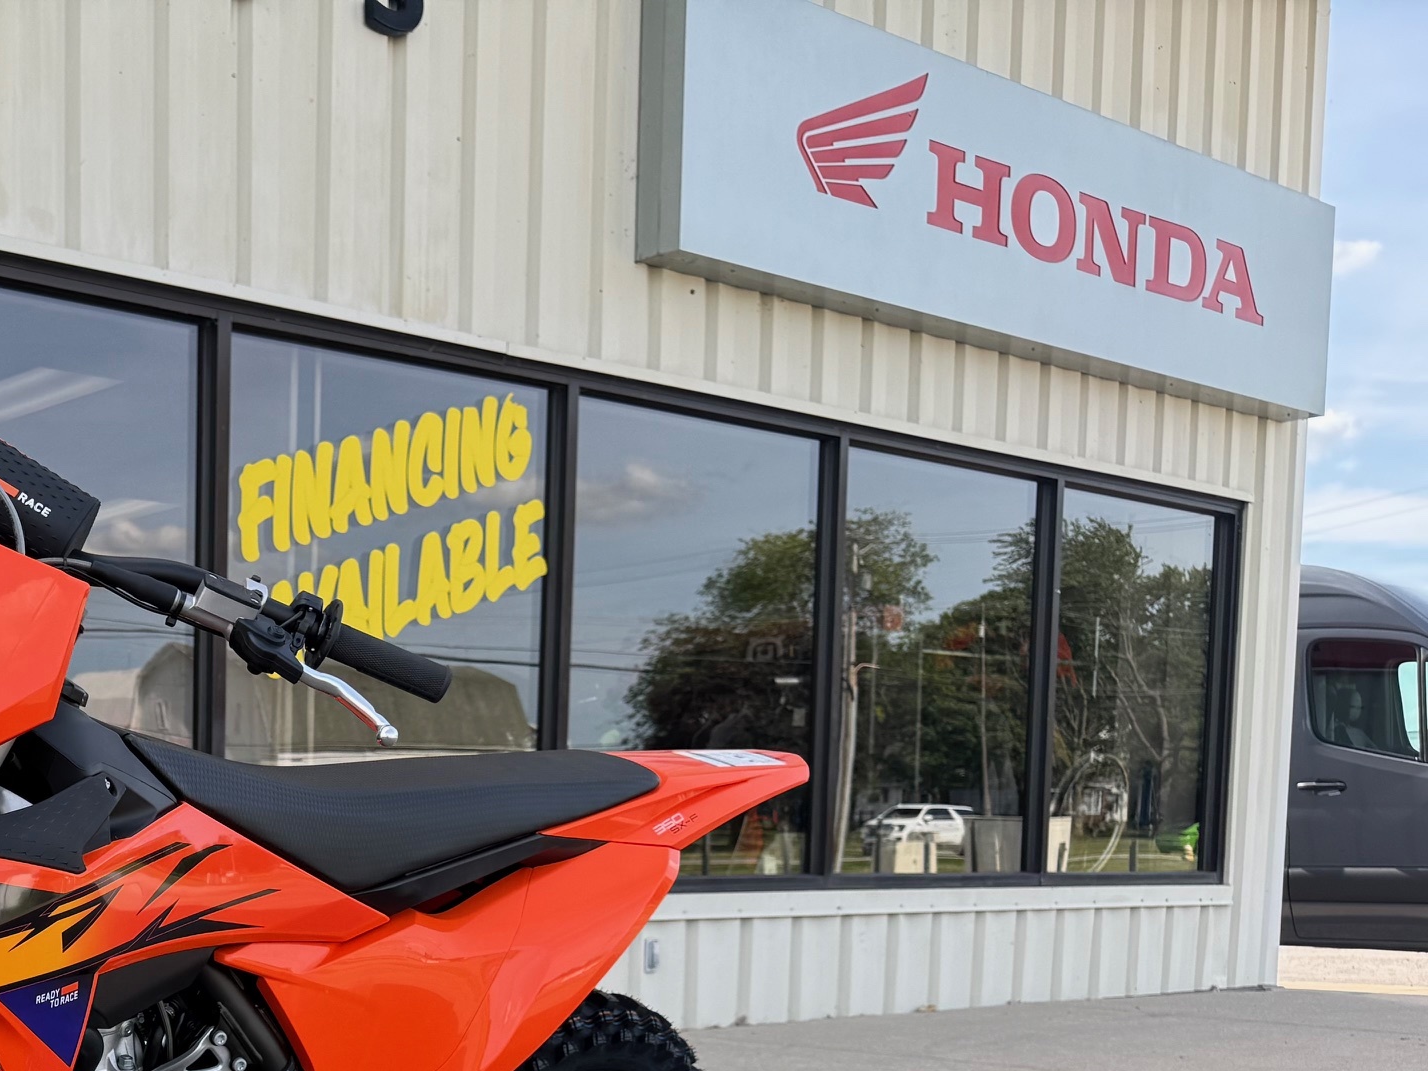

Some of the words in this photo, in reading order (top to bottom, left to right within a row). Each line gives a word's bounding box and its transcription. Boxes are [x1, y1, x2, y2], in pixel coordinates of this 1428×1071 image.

[926, 139, 1264, 327] HONDA
[237, 392, 532, 562] FINANCING
[17, 491, 52, 518] RACE
[265, 499, 548, 679] AILABLE
[652, 812, 684, 836] 350
[669, 813, 699, 835] SX-F
[35, 987, 61, 1005] READY
[49, 998, 60, 1009] TO
[60, 990, 79, 1006] RACE
